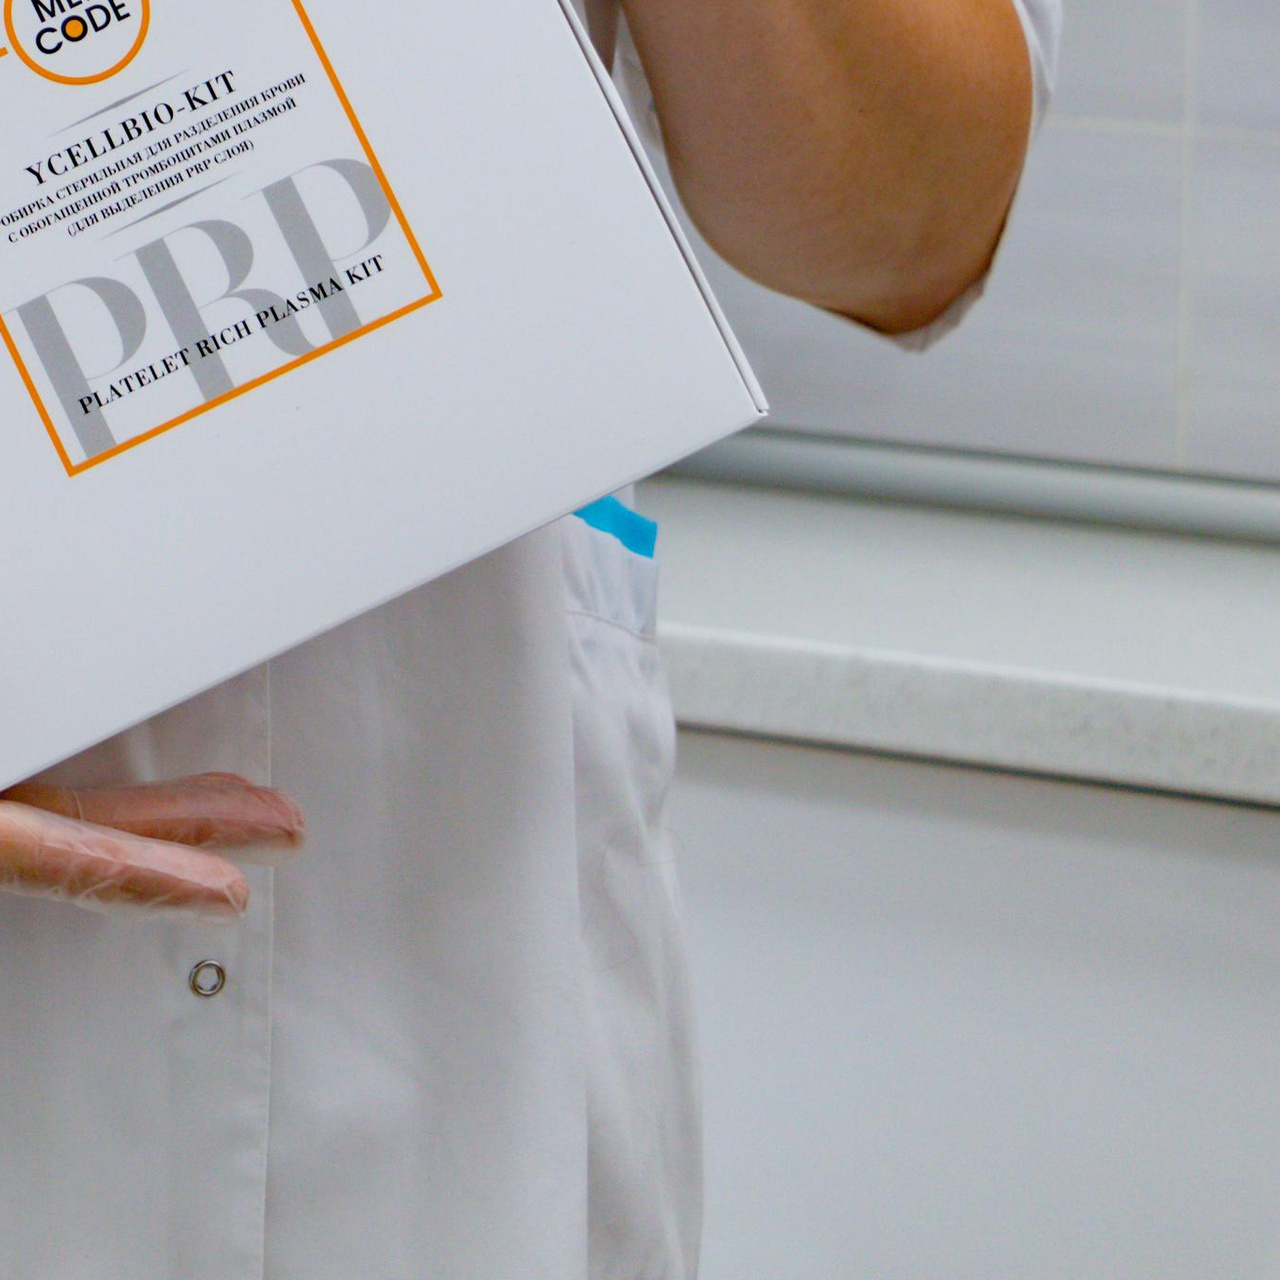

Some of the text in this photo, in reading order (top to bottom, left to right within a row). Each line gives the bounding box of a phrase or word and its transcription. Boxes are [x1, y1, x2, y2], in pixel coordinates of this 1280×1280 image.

[8, 97, 298, 244] С ОБОГАЩЕННОЙ ТРОМБОЦИТАМИ ПЛАЗМОЙ
[24, 70, 237, 187] YCELLBIO-KIT
[55, 151, 143, 201] СТЕРИЛЬНАЯ
[145, 137, 173, 161] ДЛЯ
[173, 96, 260, 145] РАЗДЕЛЕНИЯ
[261, 73, 307, 102] КРОВИ
[67, 139, 256, 238] (ДЛЯ ВЫДЕЛЕНИЯ PRP СЛОЯ)
[0, 158, 393, 460] PRP
[78, 254, 385, 415] PLATELET RICH PLASMA KIT
